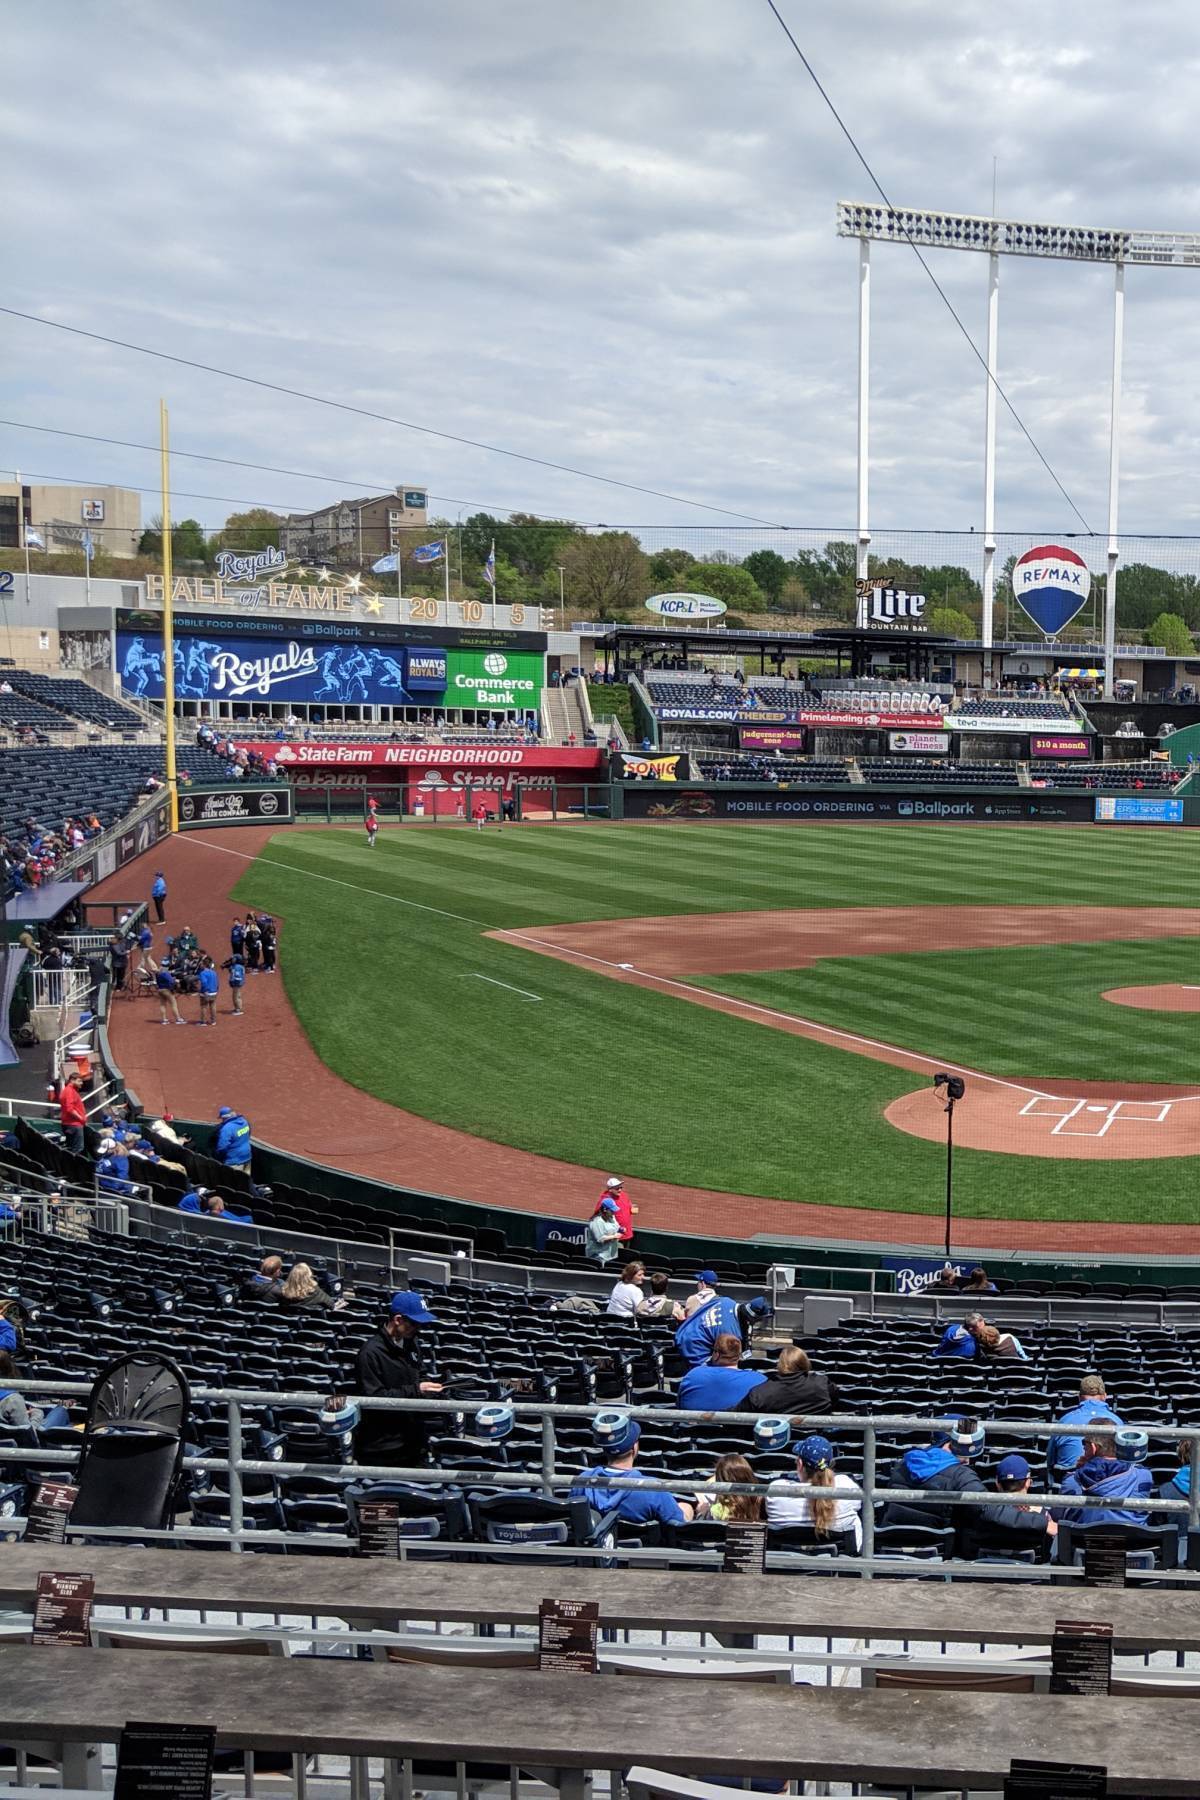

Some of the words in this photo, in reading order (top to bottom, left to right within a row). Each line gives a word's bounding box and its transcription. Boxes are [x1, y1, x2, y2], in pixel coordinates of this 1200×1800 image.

[216, 546, 288, 582] Royals
[1023, 568, 1081, 586] RE/MAX
[146, 574, 235, 605] HALL
[239, 585, 267, 609] of
[268, 582, 355, 612] FAME
[855, 576, 896, 597] Miller
[410, 596, 439, 620] 20
[460, 600, 483, 622] 10
[660, 600, 694, 613] KCP&L
[870, 586, 926, 624] Lite
[511, 603, 525, 624] 5
[207, 619, 233, 629] FOOD
[236, 621, 284, 632] ORDERING
[315, 624, 362, 638] Ballpark
[867, 622, 909, 632] FOUNTAIN
[912, 624, 928, 632] BAR
[212, 641, 318, 697] Royals
[410, 658, 446, 669] ALWAYS
[409, 667, 438, 678] ROYAL
[455, 675, 535, 691] Commerce
[477, 690, 515, 704] Bank
[801, 712, 863, 724] PrimeLending
[957, 718, 977, 727] teva
[908, 734, 937, 744] planet
[913, 741, 944, 750] fitness
[1037, 740, 1051, 749] $10
[1059, 741, 1086, 750] month
[385, 748, 523, 764] NEIGHBORHOOD
[626, 761, 676, 775] SONIC
[727, 801, 773, 811] MOBILE
[775, 801, 810, 812] FOOD
[813, 802, 875, 813] ORDERING
[914, 801, 975, 817] Ballpark
